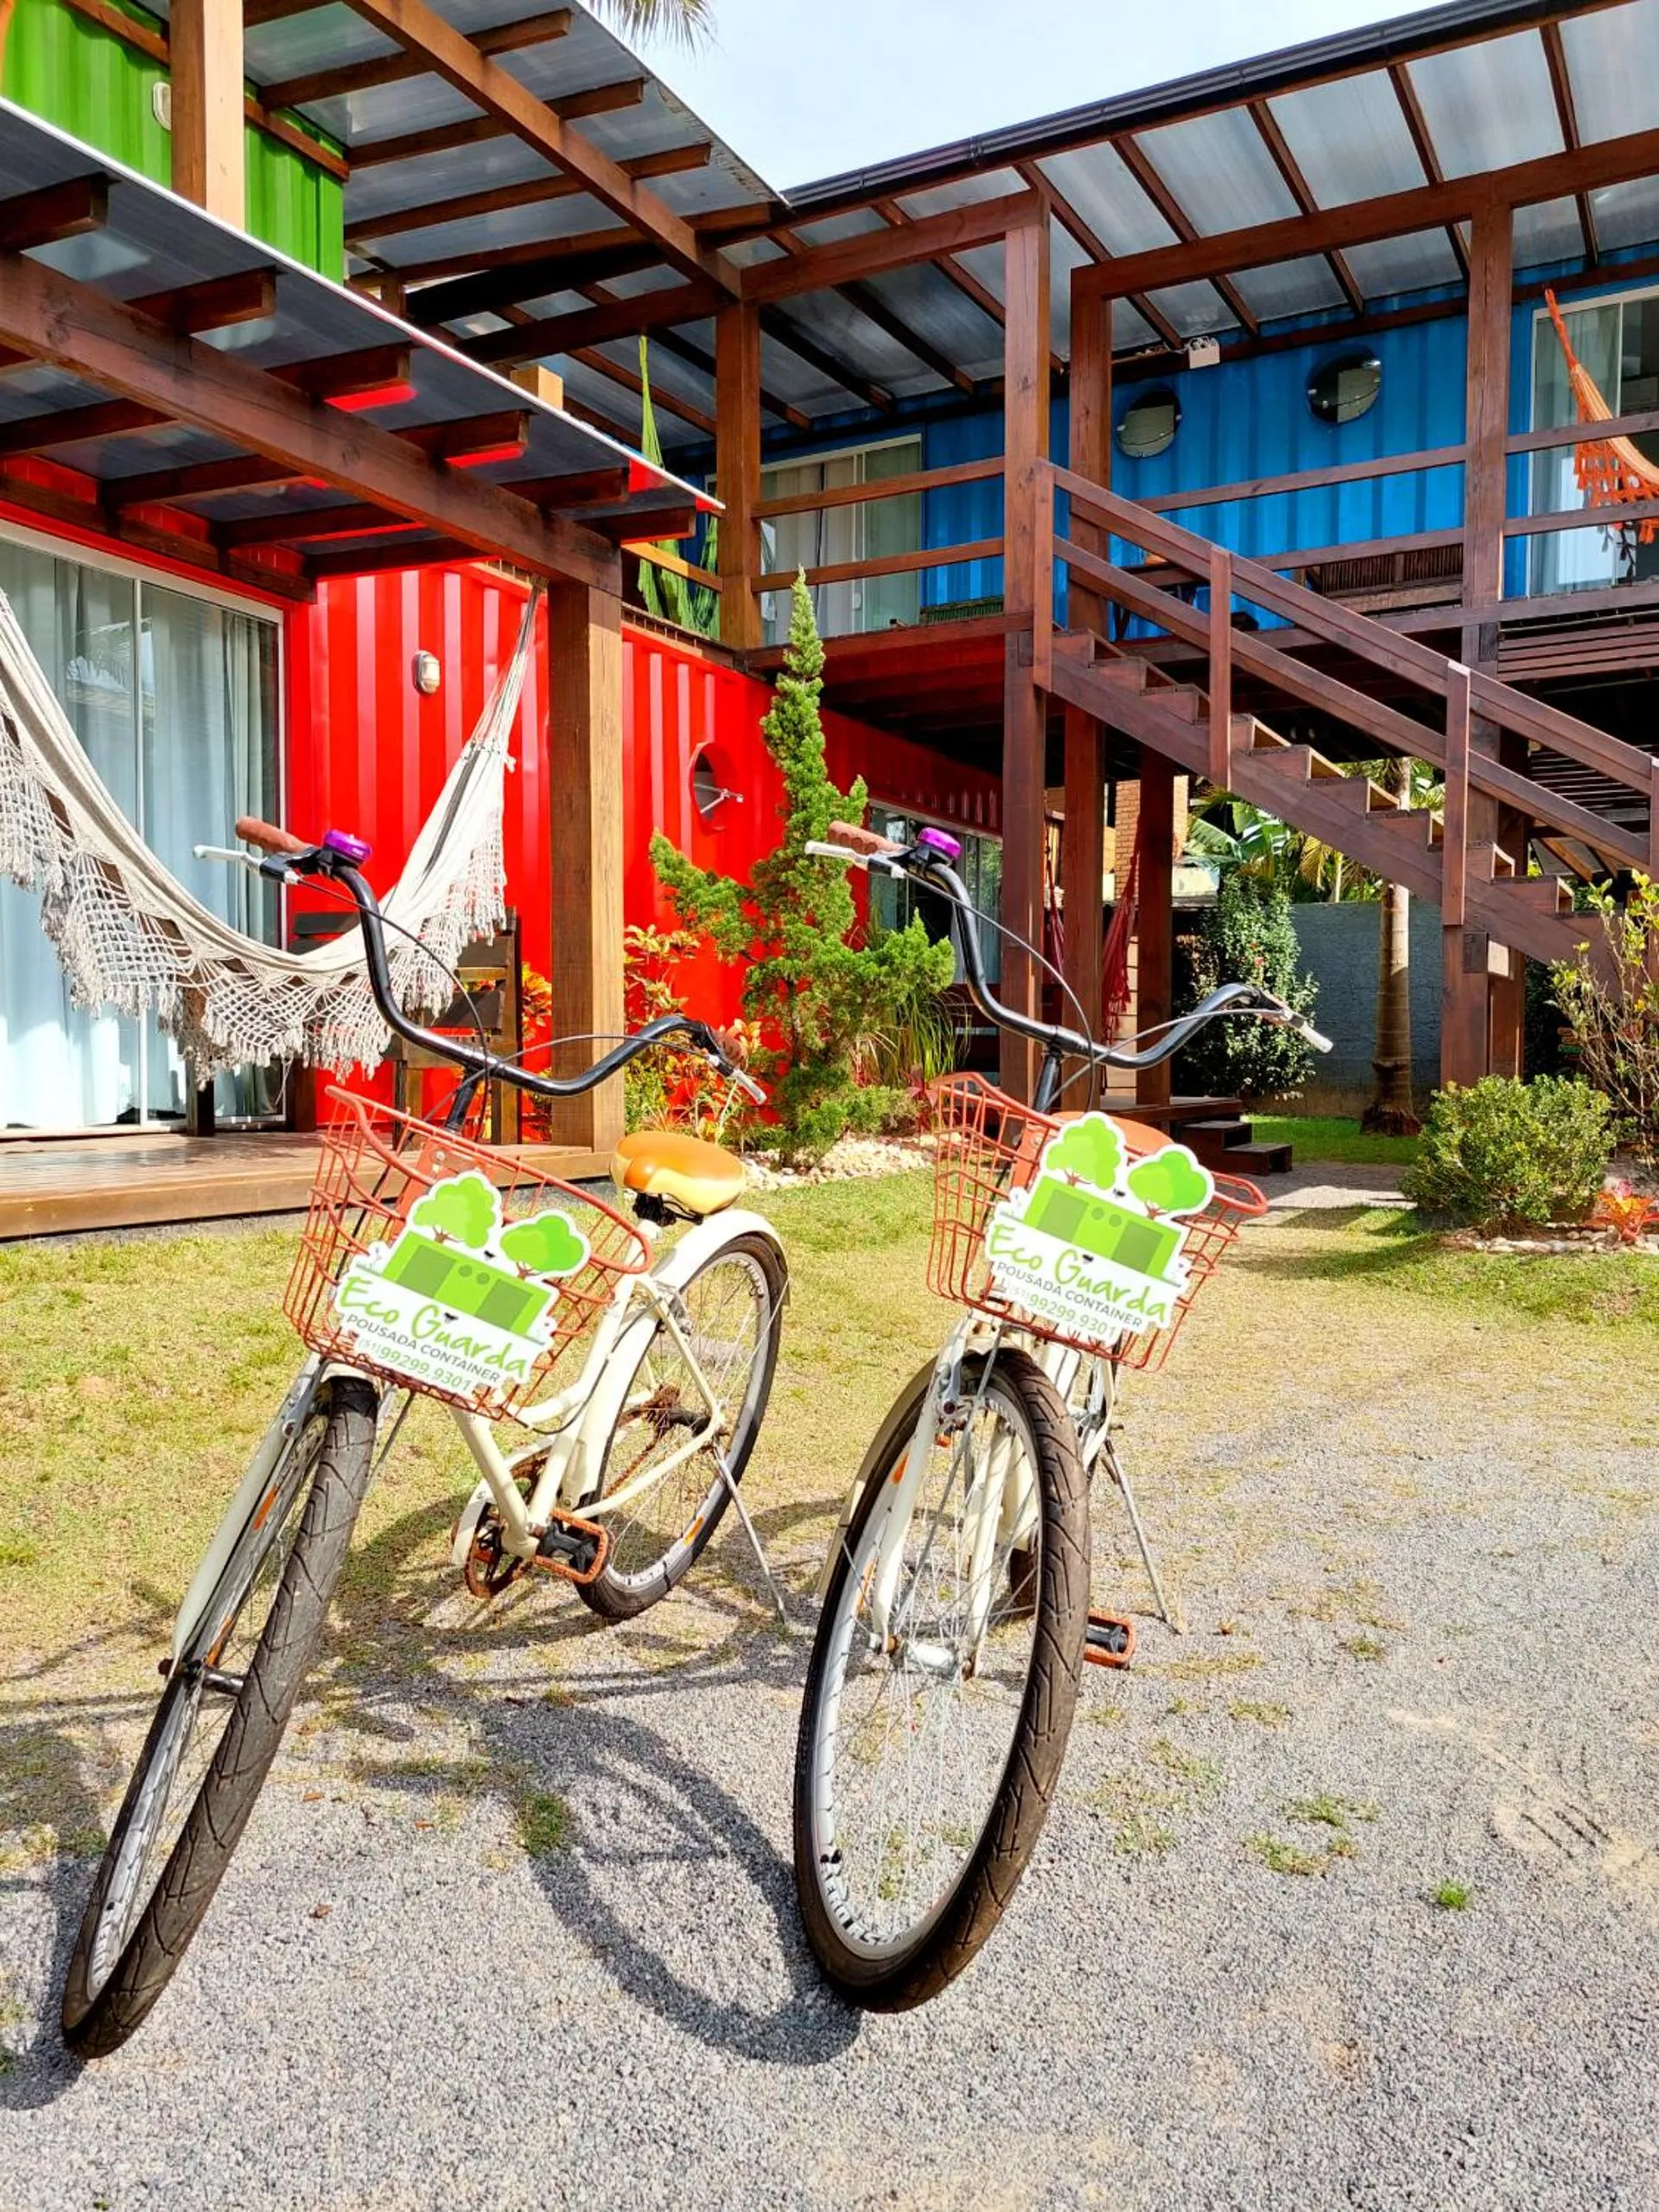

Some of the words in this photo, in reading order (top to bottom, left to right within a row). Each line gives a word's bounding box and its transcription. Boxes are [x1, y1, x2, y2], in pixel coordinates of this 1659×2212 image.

[990, 1224, 1042, 1270] Eco
[1054, 1249, 1166, 1324] Guarda
[995, 1261, 1062, 1296] POUSADA
[1065, 1289, 1143, 1328] CONTAINER
[340, 1277, 400, 1323] Eco
[411, 1304, 529, 1379] Guarda
[346, 1313, 417, 1350] POUSADA
[420, 1344, 500, 1382] CONTAINER
